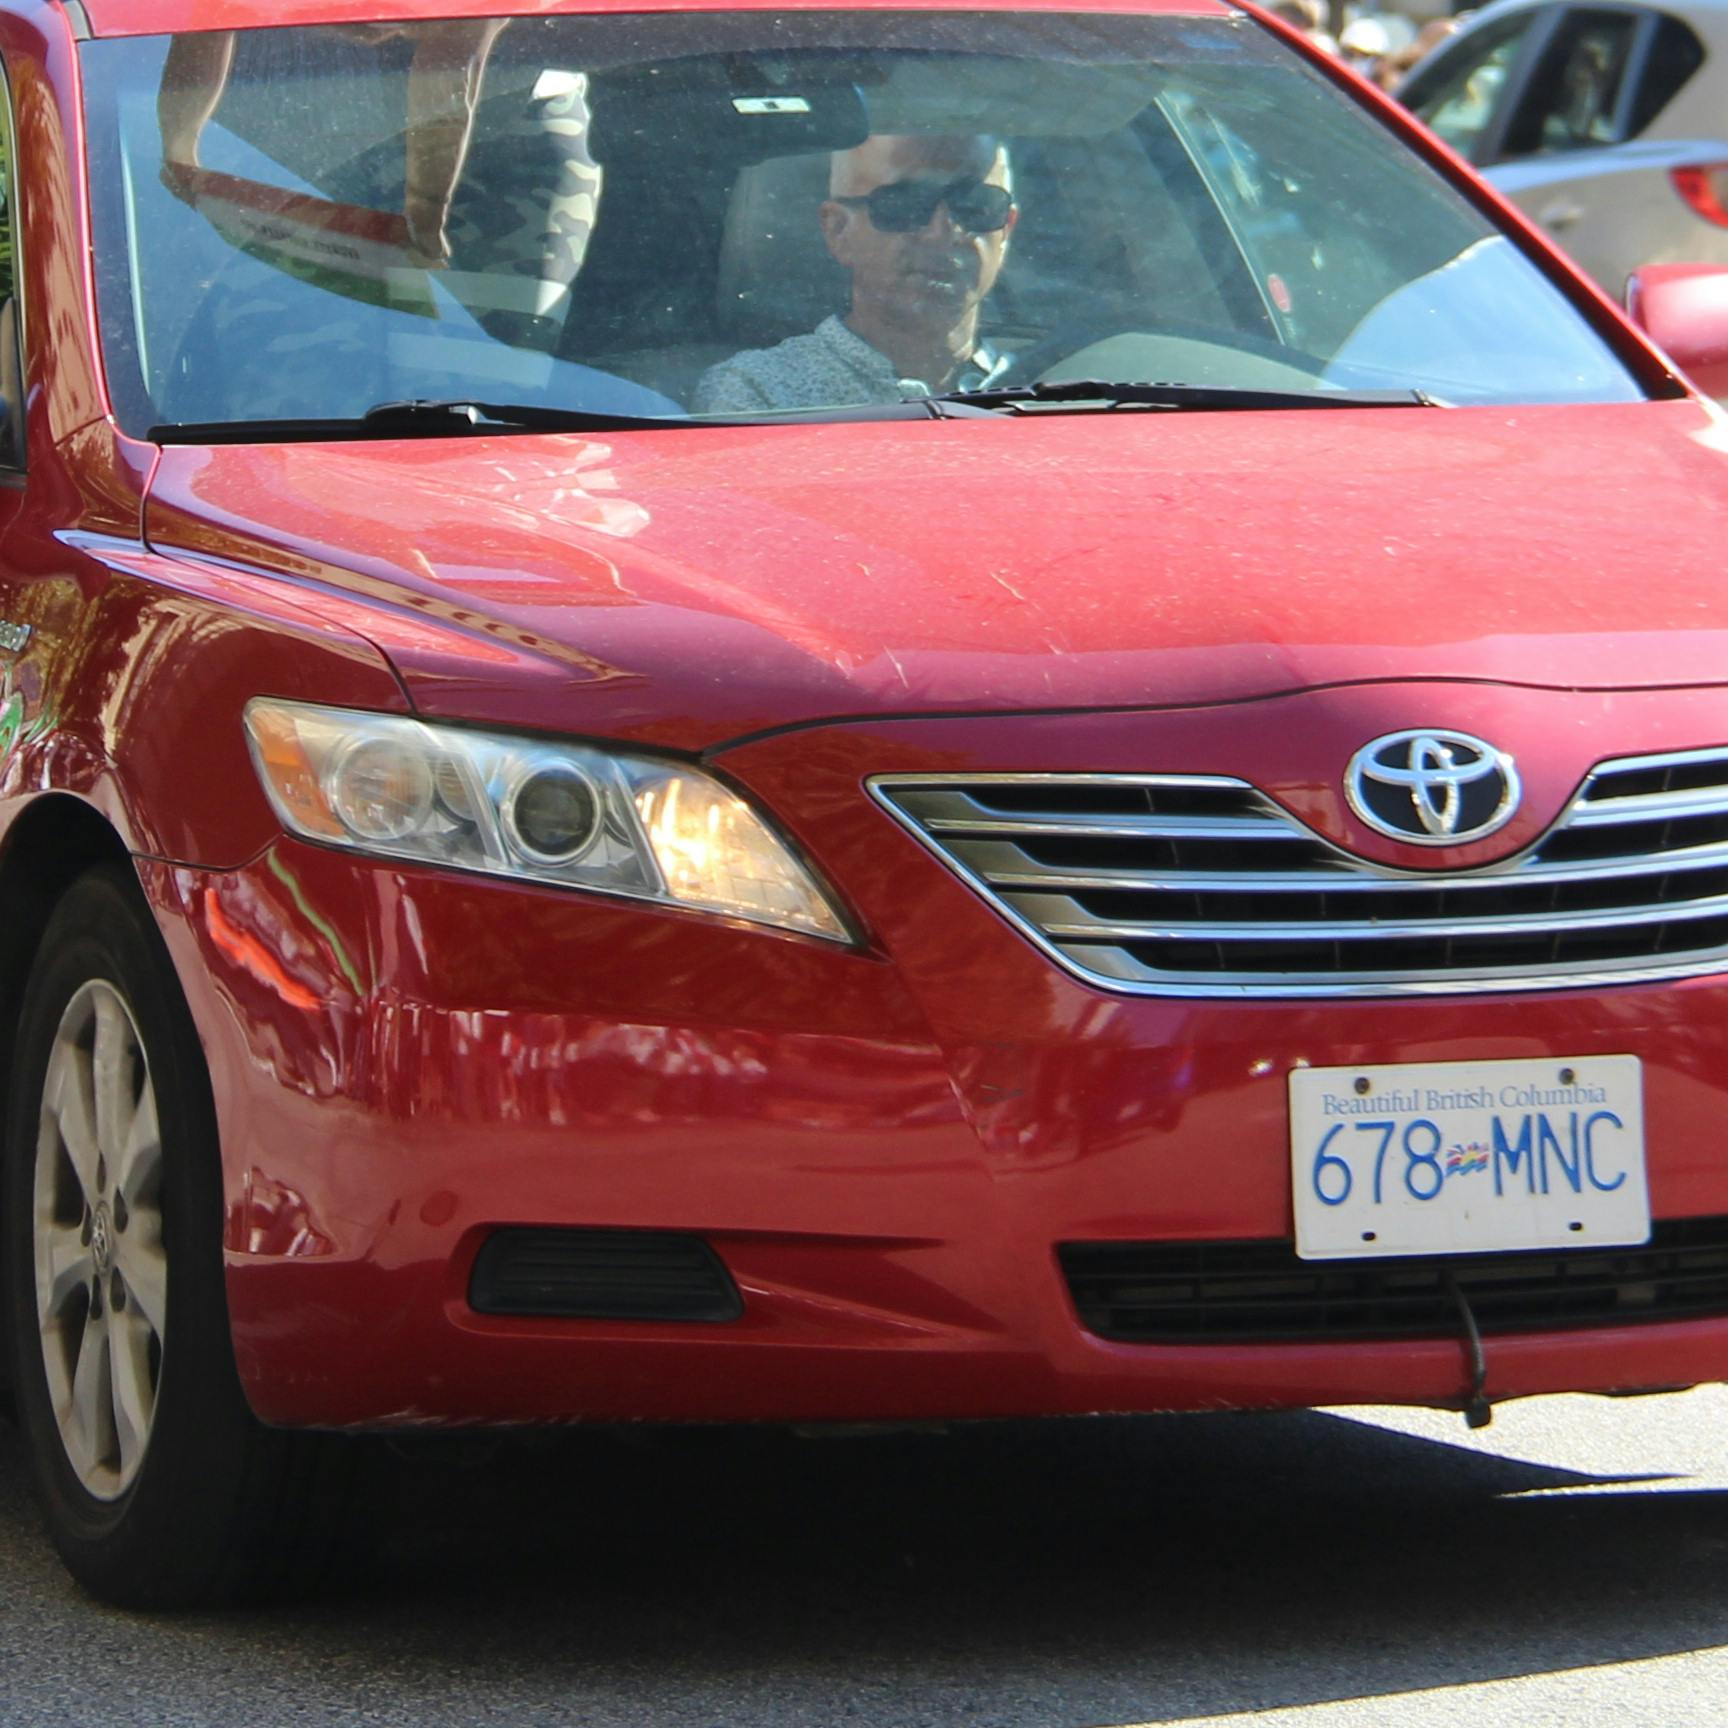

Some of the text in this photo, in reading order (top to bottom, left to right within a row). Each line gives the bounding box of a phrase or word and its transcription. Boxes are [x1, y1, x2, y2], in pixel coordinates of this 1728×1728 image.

[1322, 1082, 1608, 1116] Beautiful British Columbia
[1312, 1110, 1627, 1207] 678 MNC
